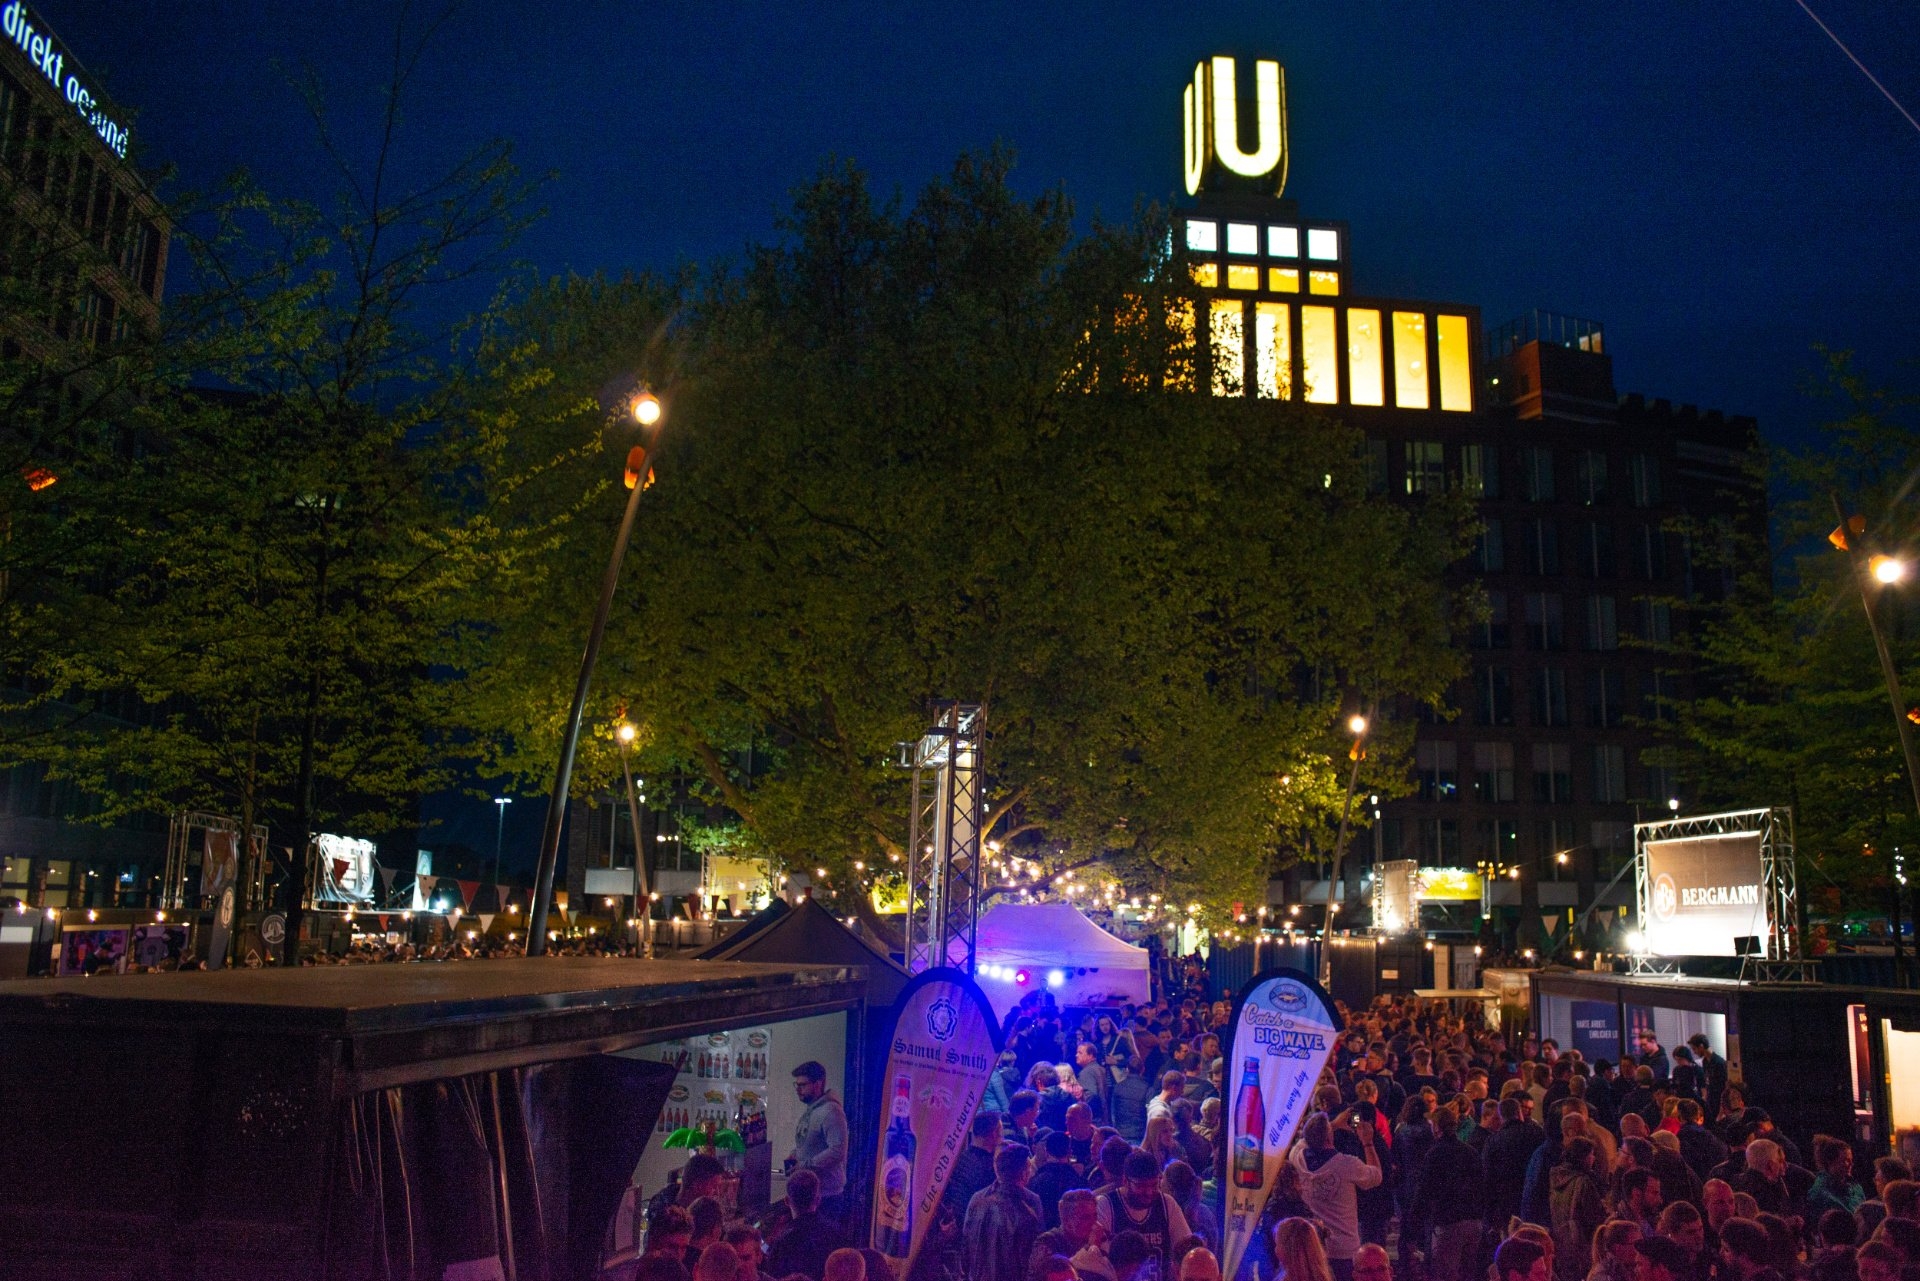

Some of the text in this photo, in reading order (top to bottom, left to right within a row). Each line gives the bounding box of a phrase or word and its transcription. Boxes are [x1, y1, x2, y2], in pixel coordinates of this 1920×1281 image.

[2, 0, 64, 88] direkt
[1212, 56, 1282, 177] U
[1681, 885, 1758, 906] BERGMANN
[1245, 1002, 1283, 1026] Catch
[1255, 1028, 1280, 1045] BIG
[945, 1047, 987, 1073] Smith
[1267, 1045, 1294, 1058] Golden
[1269, 1126, 1281, 1147] All
[1286, 1088, 1302, 1111] every
[1294, 1070, 1309, 1087] day
[921, 1090, 977, 1214] The Old Brewery
